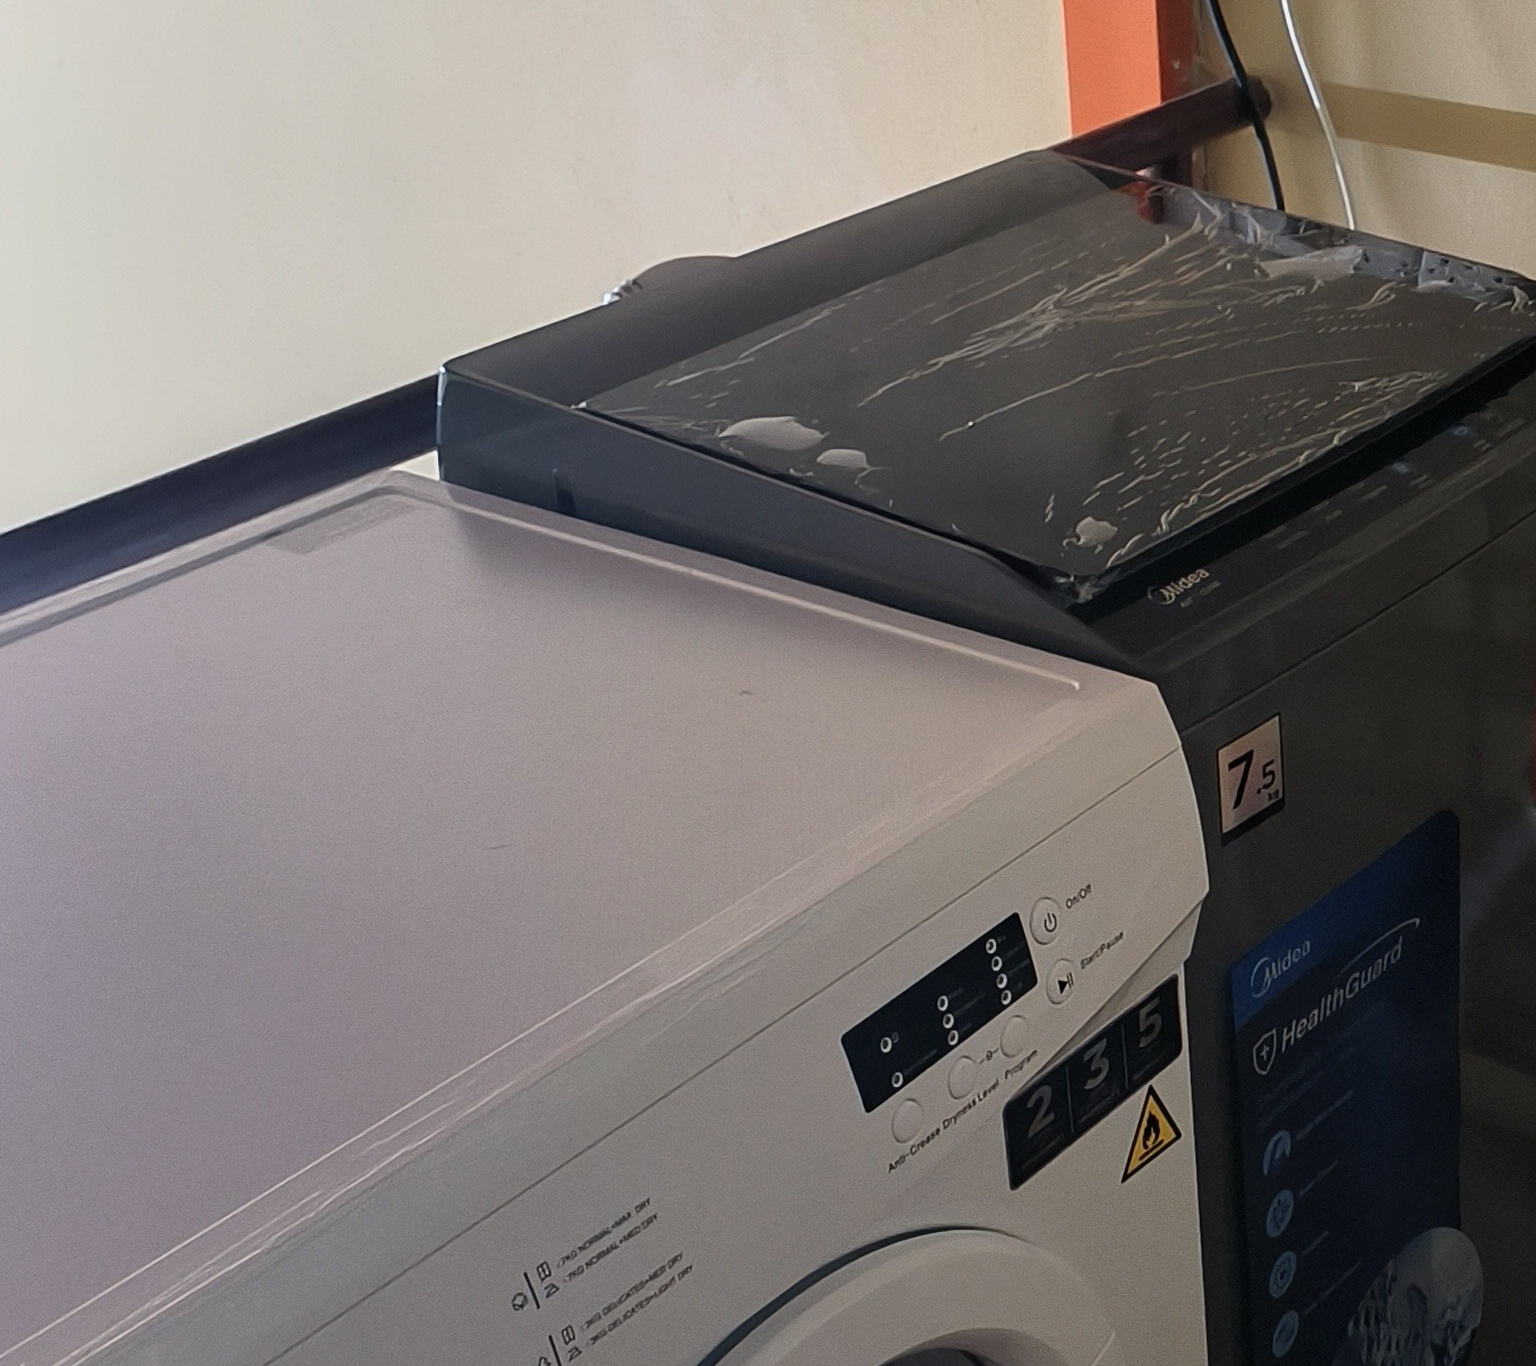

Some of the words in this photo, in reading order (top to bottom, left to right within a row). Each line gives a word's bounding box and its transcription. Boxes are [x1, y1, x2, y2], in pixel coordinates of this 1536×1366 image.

[1147, 569, 1210, 605] Midea
[1250, 940, 1311, 998] Midea
[1281, 935, 1403, 1053] HealthGuard
[1138, 996, 1163, 1048] 5
[1083, 1037, 1110, 1090] 3
[977, 1078, 1000, 1103] Level
[1026, 1085, 1055, 1139] 2
[888, 1127, 941, 1173] Anti-Crease
